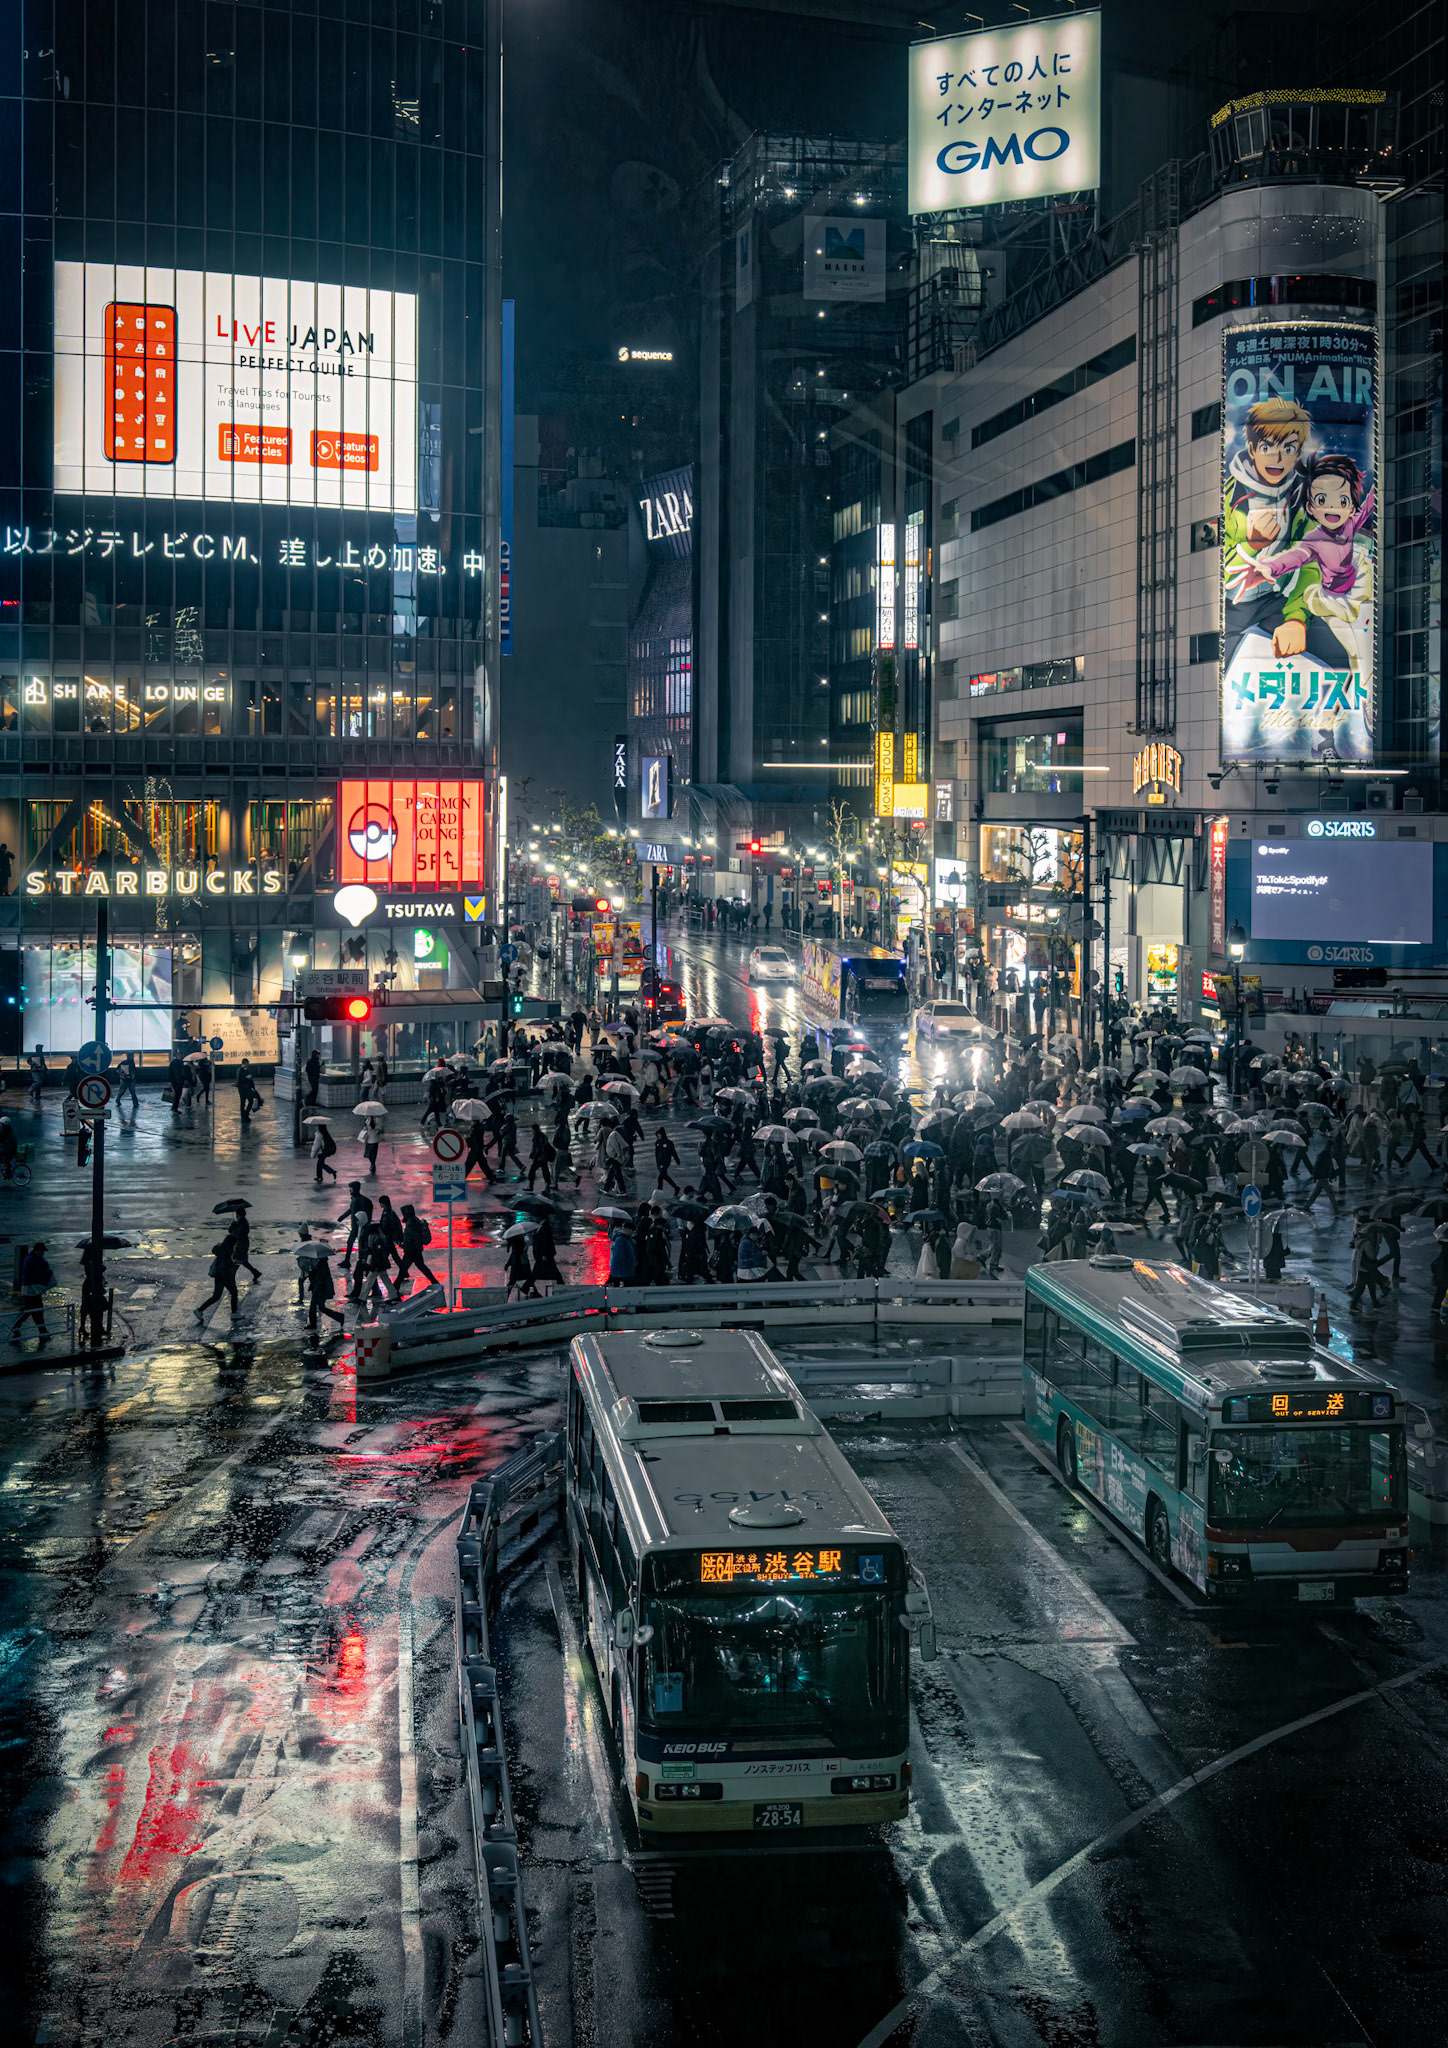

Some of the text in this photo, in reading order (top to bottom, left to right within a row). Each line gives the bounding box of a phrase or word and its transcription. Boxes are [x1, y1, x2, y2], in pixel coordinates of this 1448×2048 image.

[936, 53, 1071, 96] すべての人に
[936, 85, 1071, 127] インターネット
[936, 127, 1071, 175] GMO
[217, 315, 375, 355] LIVE JAPAN
[631, 350, 673, 361] sequence
[240, 355, 354, 377] PERFECT GUIDE
[217, 384, 249, 396] Travel
[1226, 365, 1374, 407] ON AIR
[217, 398, 226, 406] in
[236, 399, 281, 411] languages
[244, 433, 288, 446] Featured
[335, 440, 376, 454] Featurd
[243, 445, 282, 457] Artcles
[335, 452, 366, 464] Vdeos
[639, 490, 694, 541] ZARA
[54, 684, 225, 701] SHARE LOUNGE
[1231, 662, 1368, 711] メダリスト
[882, 733, 892, 773] TOUCH
[615, 743, 626, 788] ZARA
[1133, 742, 1182, 794] MAGNET
[420, 813, 457, 825] CARD
[411, 828, 465, 840] OUNGE
[1325, 821, 1376, 837] STARTS
[646, 844, 669, 862] ZARA
[1268, 847, 1290, 855] Spotify
[417, 853, 437, 871] 5F
[26, 871, 281, 895] STARBUCKS
[385, 904, 455, 918] TSUTAYA
[1325, 946, 1374, 962] STARTS
[307, 973, 364, 985] 渋谷駅前
[1272, 1393, 1345, 1412] 回 送
[702, 1554, 733, 1580] 渋64
[764, 1550, 842, 1573] 渋谷駅
[663, 1742, 728, 1754] KEIO BUS
[744, 1762, 811, 1775] ノンステップバス
[761, 1810, 801, 1827] 28-54
